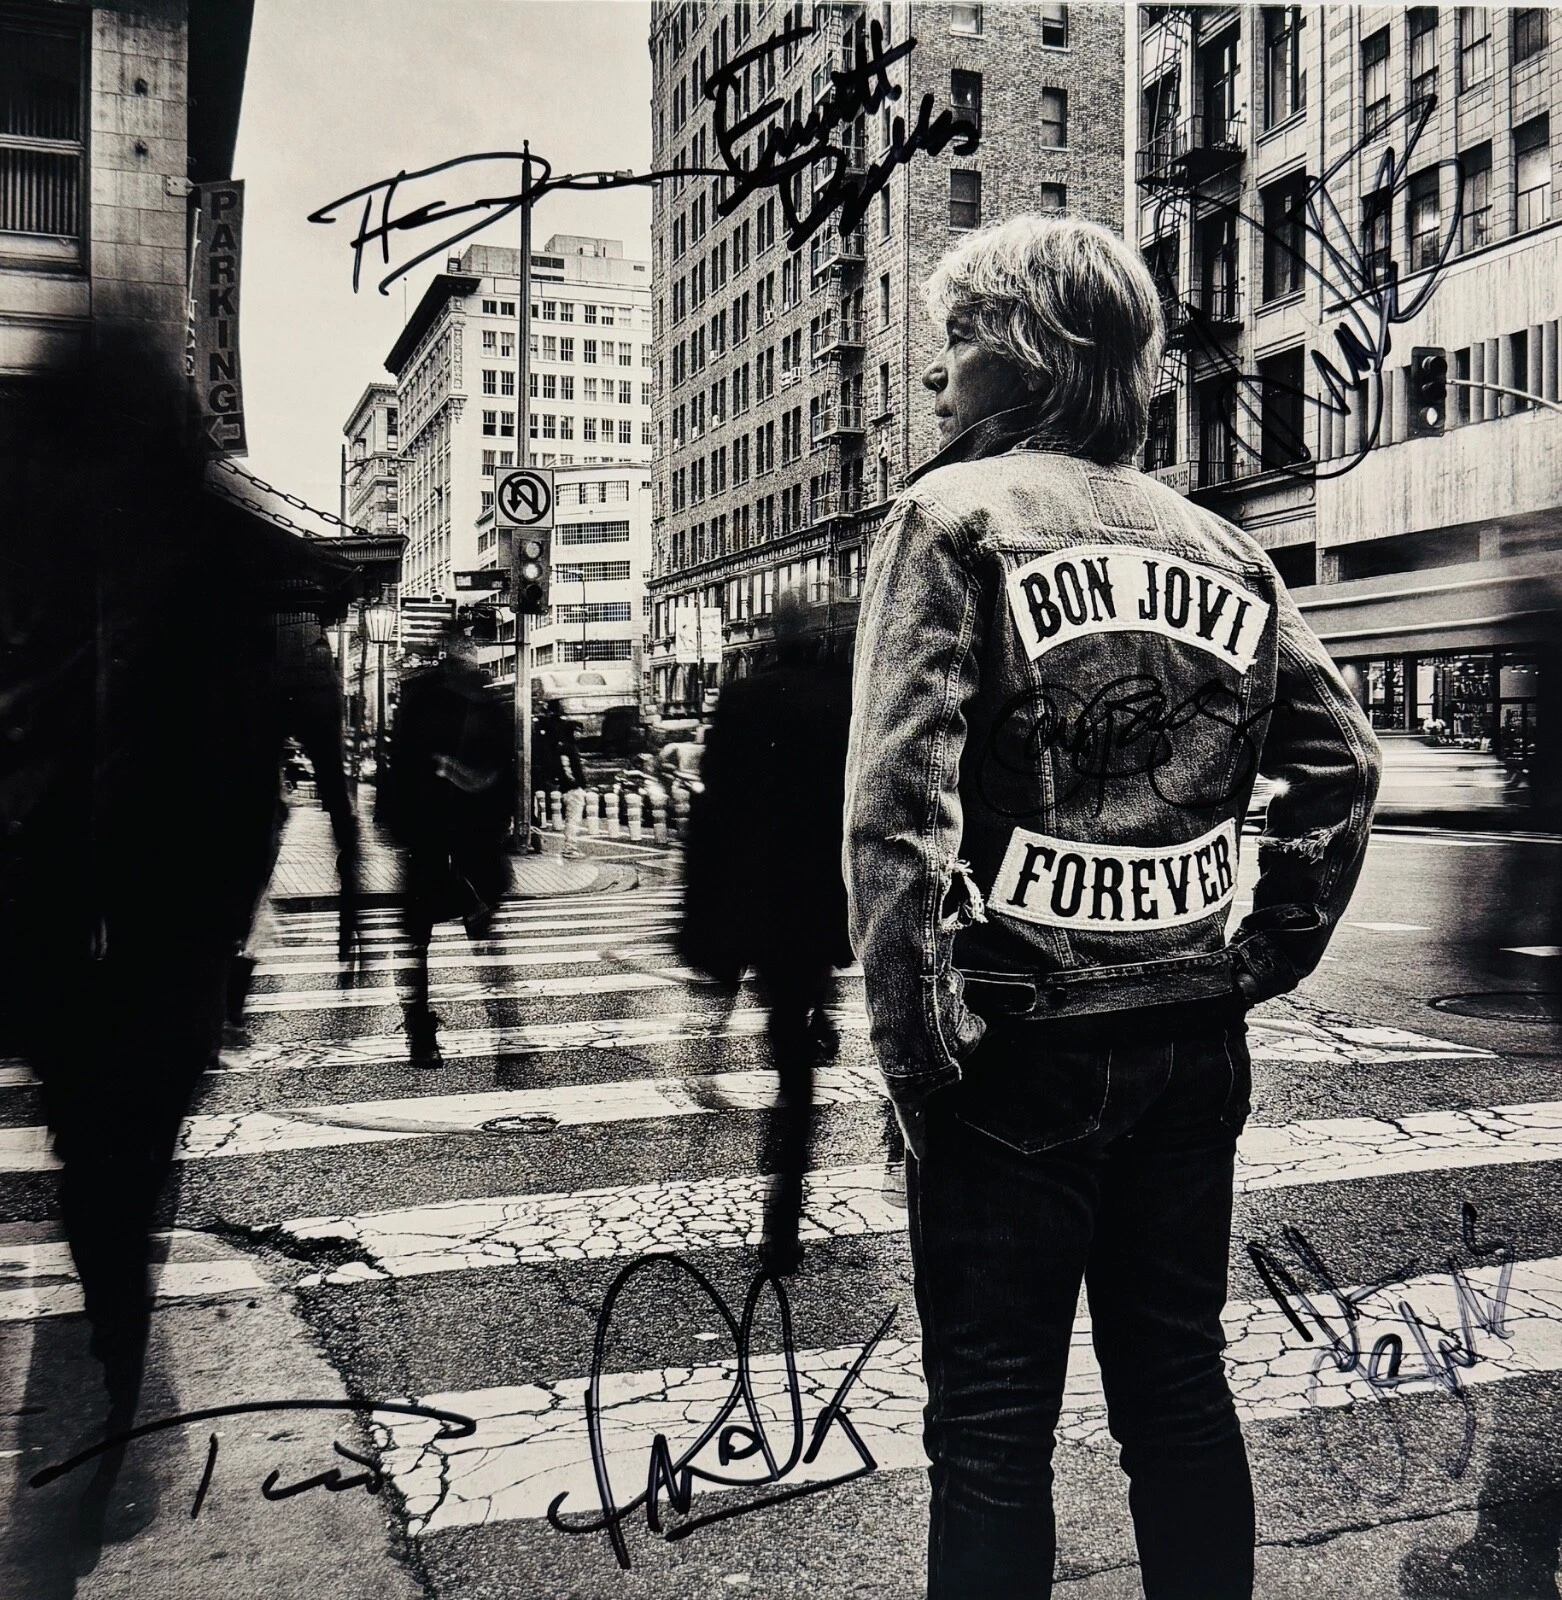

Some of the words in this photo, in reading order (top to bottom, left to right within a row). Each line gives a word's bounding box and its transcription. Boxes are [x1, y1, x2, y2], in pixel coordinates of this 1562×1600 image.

[208, 190, 239, 414] PARKING
[1019, 556, 1118, 644] BON
[1137, 559, 1256, 656] JOVI
[1006, 833, 1235, 923] FOREVER
